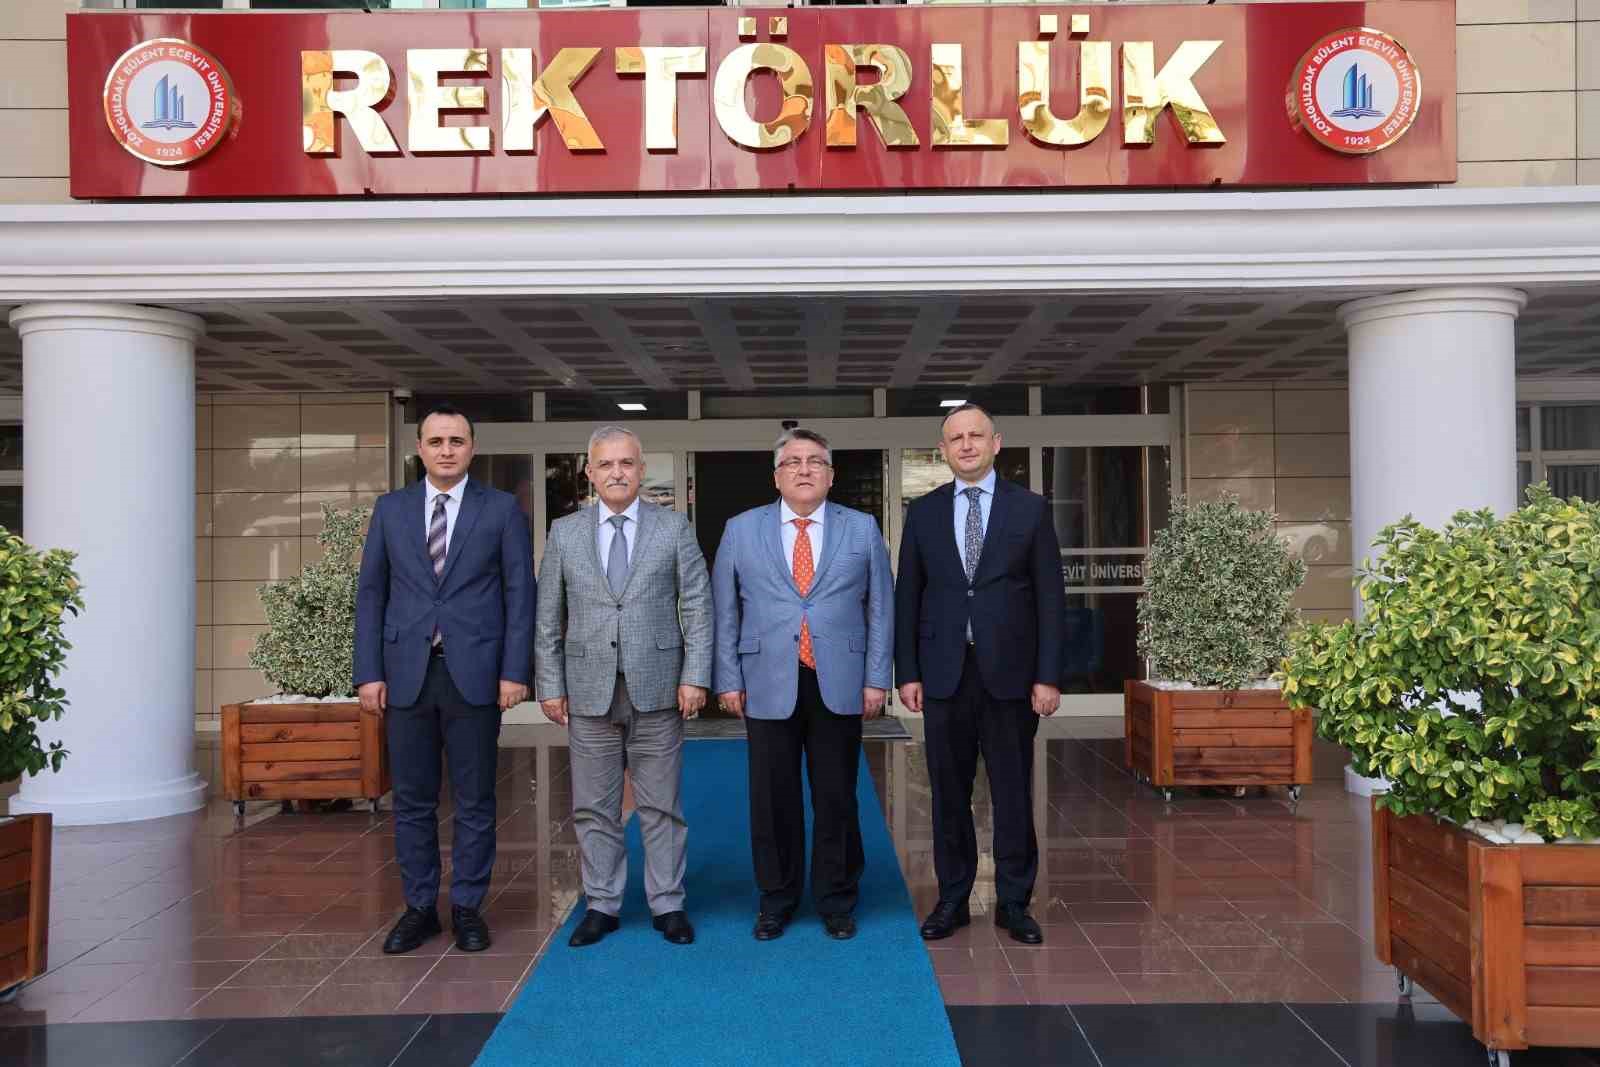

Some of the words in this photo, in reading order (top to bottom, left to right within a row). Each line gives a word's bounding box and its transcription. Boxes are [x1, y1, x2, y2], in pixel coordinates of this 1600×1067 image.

[123, 48, 165, 76] BÜLENT
[168, 47, 210, 72] ECEVİT
[1312, 36, 1355, 65] BÜLENT
[1358, 36, 1399, 59] ECEVİT
[301, 14, 1227, 153] REKTÖRLÜK
[112, 76, 143, 146] ZONGULDAK
[194, 71, 225, 150] ÜNİVERSİTESİ
[1302, 65, 1333, 136] ZONGULDAK
[1383, 59, 1414, 138] ÜNİVERSİTESİ
[156, 147, 183, 157] 1924
[1344, 136, 1371, 145] 1924
